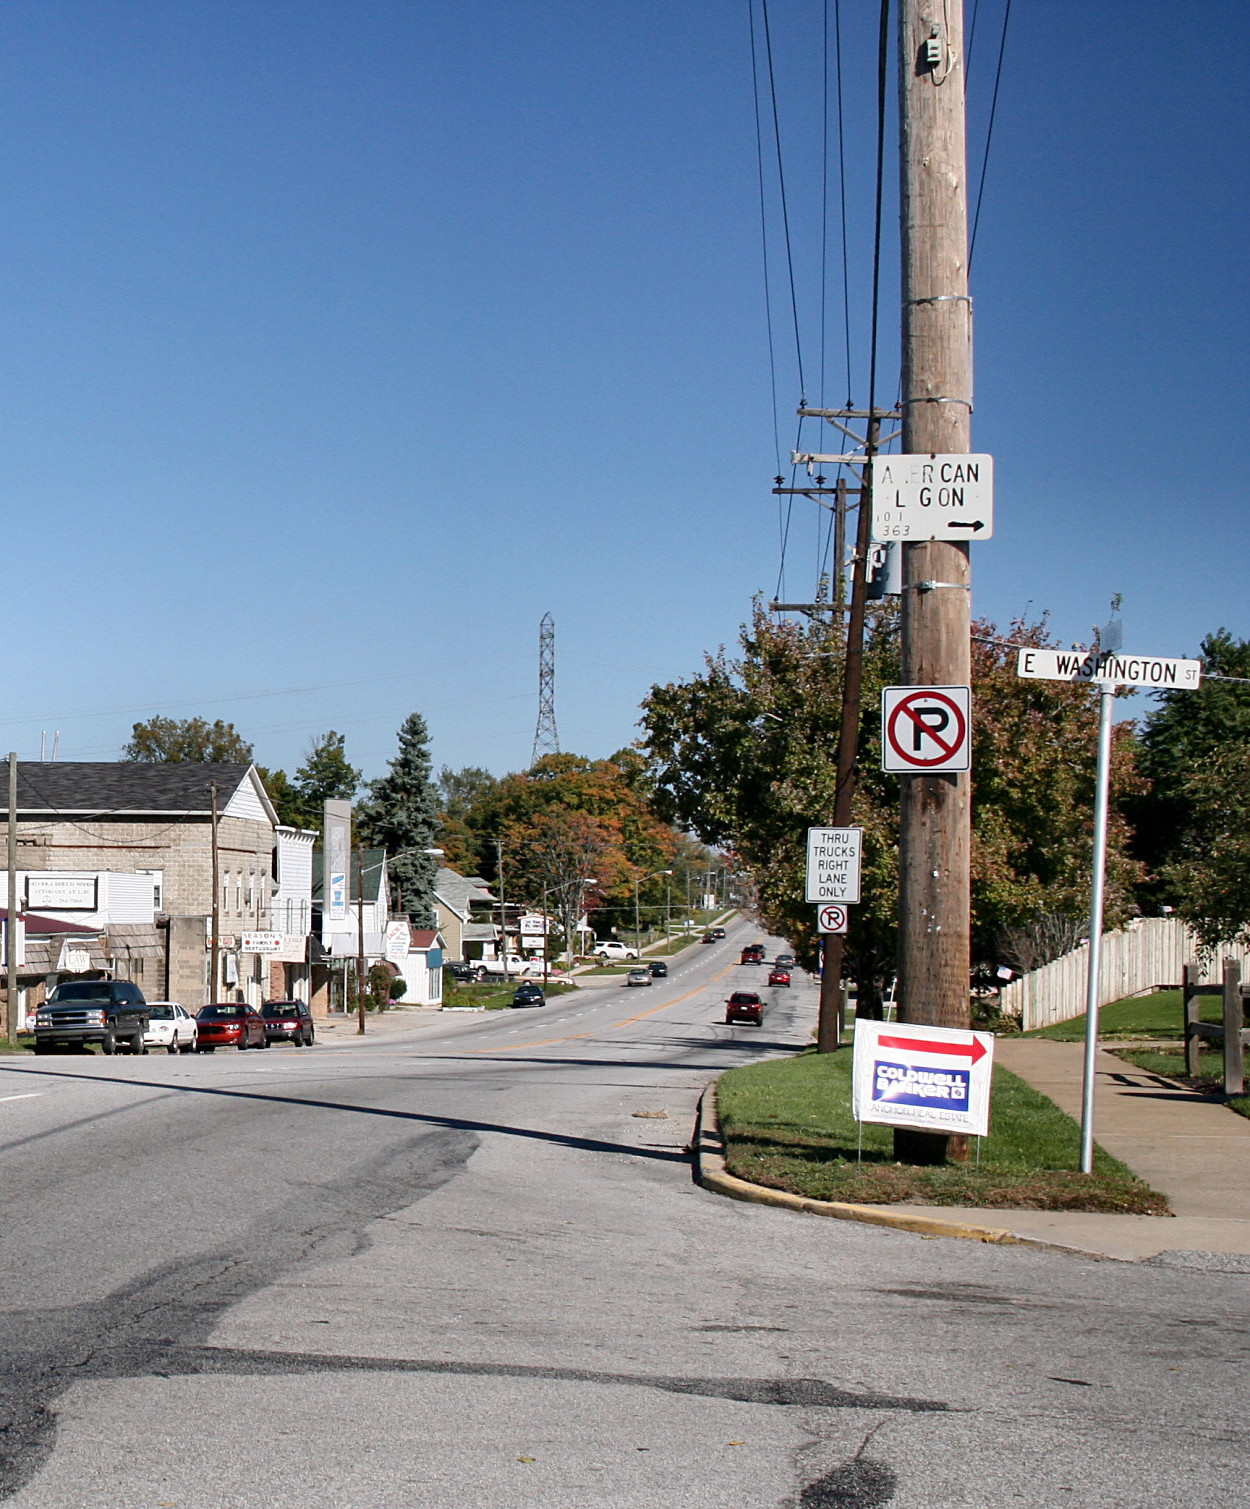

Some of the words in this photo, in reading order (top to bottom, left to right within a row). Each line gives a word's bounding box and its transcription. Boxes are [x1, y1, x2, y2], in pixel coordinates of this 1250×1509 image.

[882, 525, 911, 537] 363
[1024, 653, 1036, 673] E
[1056, 654, 1177, 683] WASHINGTON
[1184, 669, 1197, 681] ST
[821, 833, 850, 844] THRU
[813, 846, 856, 857] TRUCKS
[818, 860, 850, 871] RIGHT
[818, 873, 847, 884] LANE
[818, 886, 847, 897] ONLY
[876, 1065, 967, 1087] COLDWELL
[876, 1077, 950, 1099] BANKER
